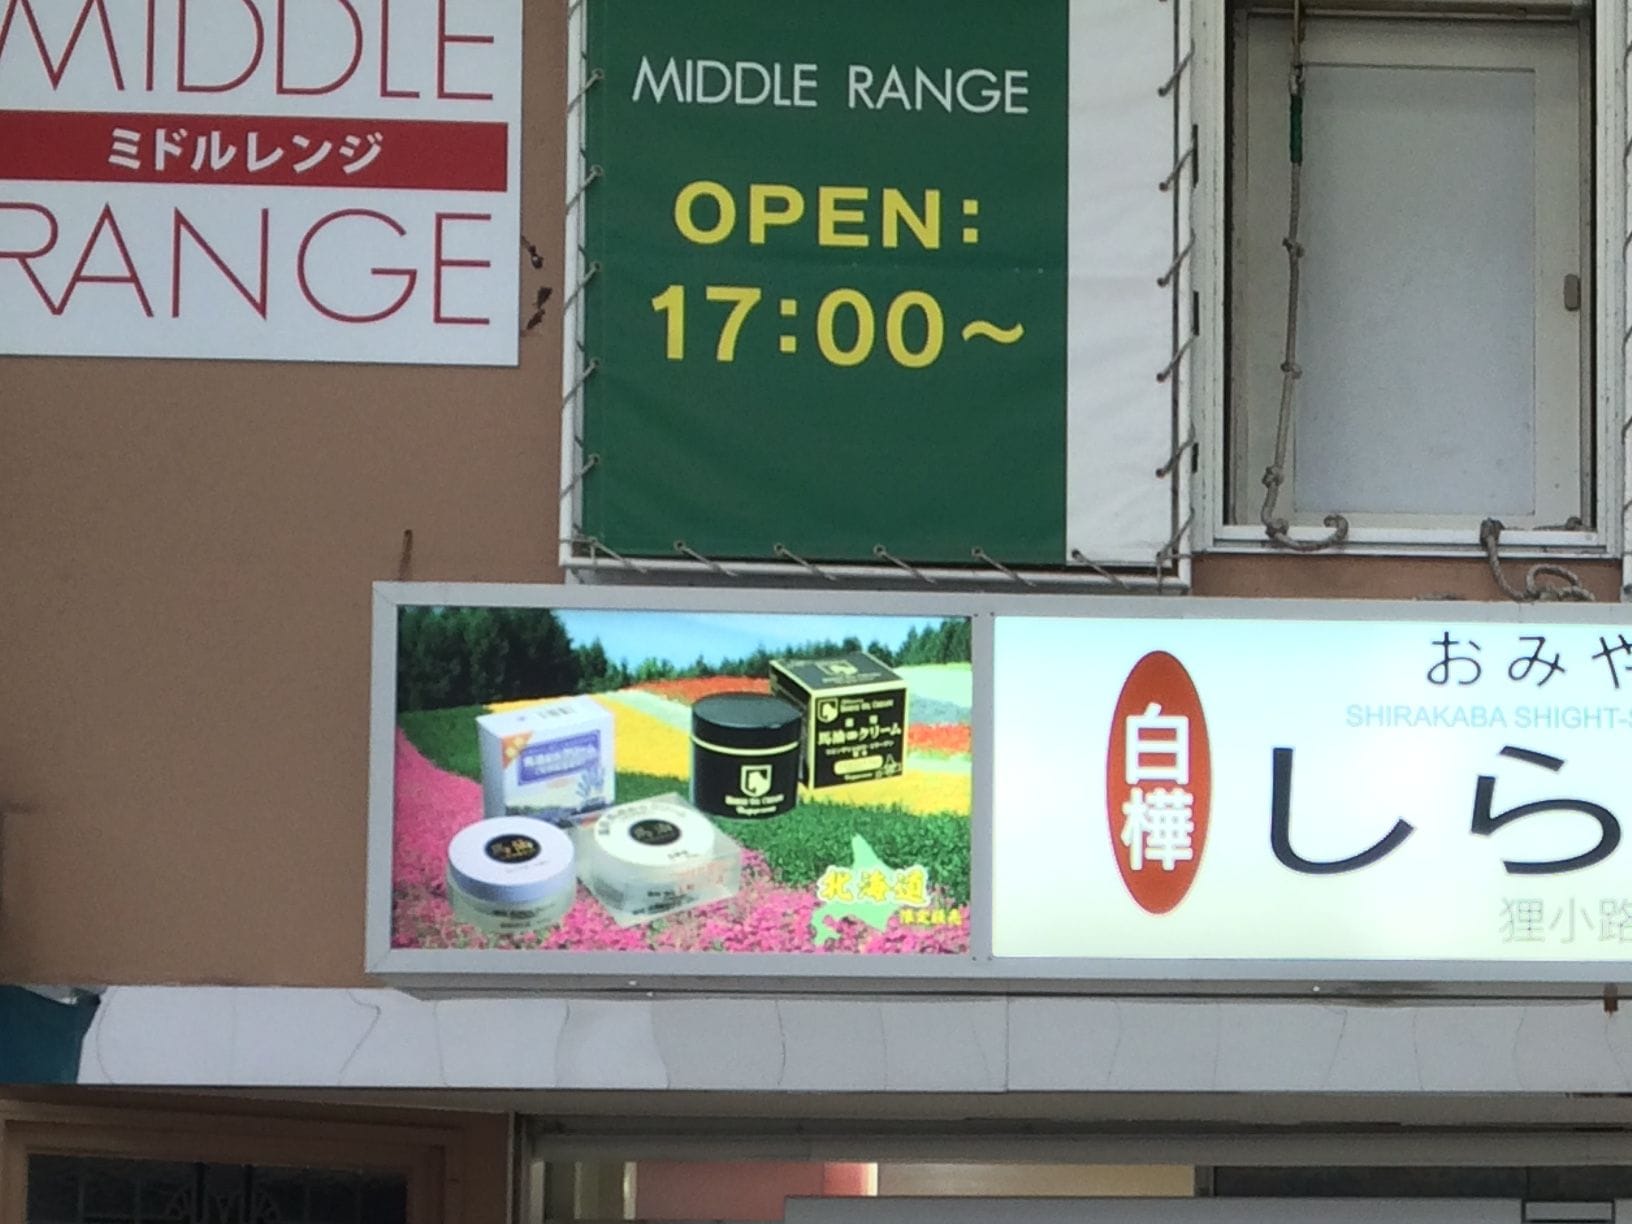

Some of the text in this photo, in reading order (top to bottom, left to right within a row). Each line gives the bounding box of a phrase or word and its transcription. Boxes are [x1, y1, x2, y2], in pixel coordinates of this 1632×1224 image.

[0, 0, 494, 99] MIDDLE
[632, 57, 1029, 114] MIDDLE RANGE
[108, 127, 383, 174] ミドルレンジ
[674, 180, 979, 249] OPEN:
[0, 201, 492, 324] RANGE
[1346, 705, 1507, 730] SHIRAKABA
[1122, 702, 1194, 871] 白樺
